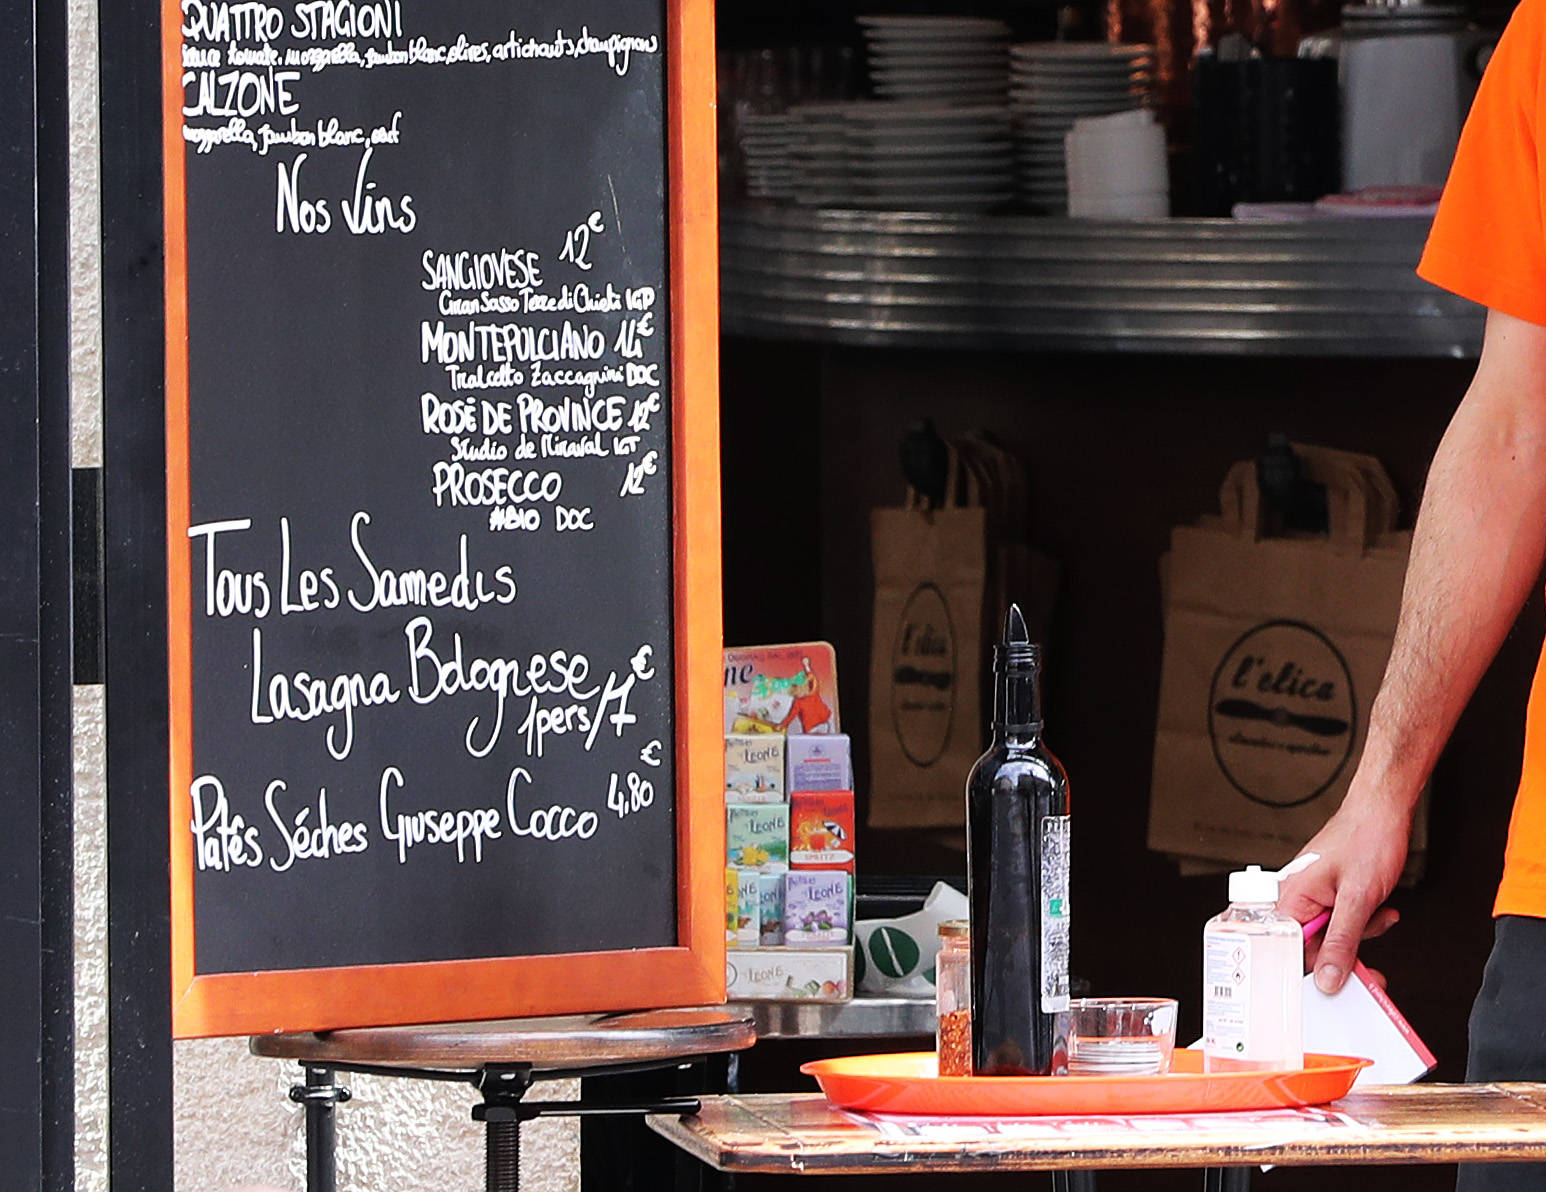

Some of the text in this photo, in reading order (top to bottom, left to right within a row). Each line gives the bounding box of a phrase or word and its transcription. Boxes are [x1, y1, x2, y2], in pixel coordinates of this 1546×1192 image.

[183, 66, 300, 117] CALZONE
[277, 147, 416, 234] Nos Vins
[421, 248, 544, 291] SANGIOVESE
[421, 320, 605, 363] MONTEPULCIANO
[626, 362, 660, 387] DOC
[481, 399, 512, 435] DE
[517, 392, 626, 434] PROVINCE
[450, 436, 508, 462] Studio
[515, 433, 537, 460] de
[432, 461, 562, 507] PROSECCO
[556, 506, 594, 531] DOC
[188, 510, 517, 617] Tous Les Samedis
[251, 616, 601, 761] Lasagna Bolognese
[1232, 655, 1335, 701] l'elica
[380, 767, 502, 864] Giuseppe
[506, 767, 598, 839] Cocco
